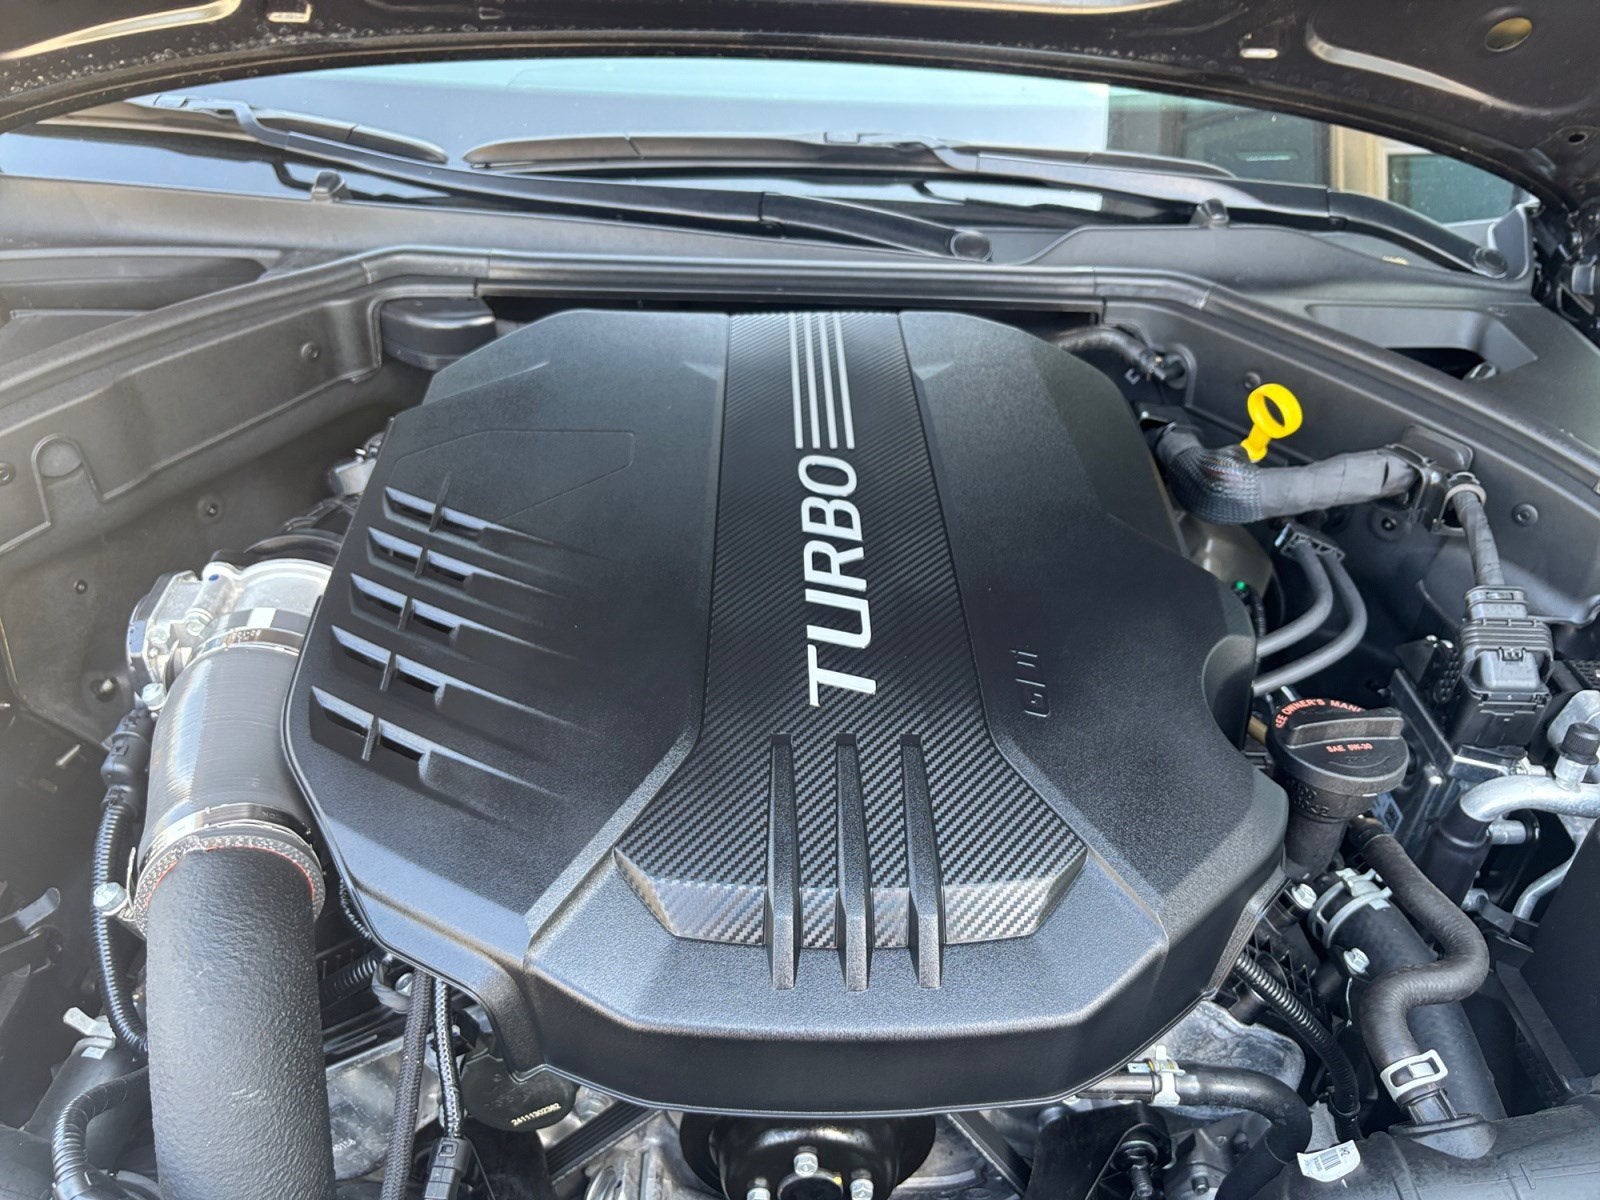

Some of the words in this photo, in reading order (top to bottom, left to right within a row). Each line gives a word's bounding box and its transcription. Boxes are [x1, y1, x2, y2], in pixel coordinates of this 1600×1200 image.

[798, 454, 877, 707] TURBO
[1281, 698, 1326, 715] OWNER'S
[1325, 744, 1346, 752] SAE
